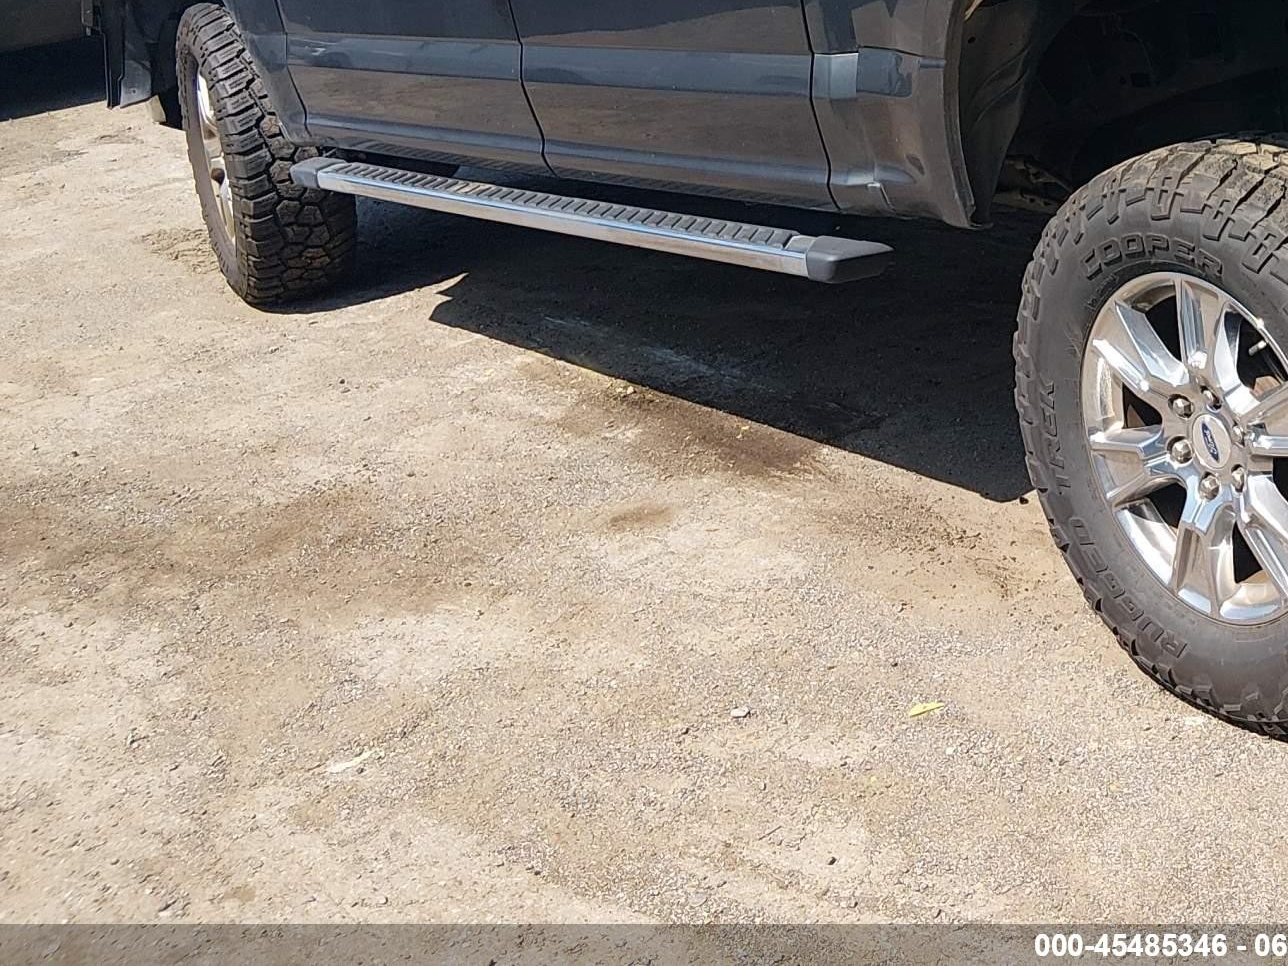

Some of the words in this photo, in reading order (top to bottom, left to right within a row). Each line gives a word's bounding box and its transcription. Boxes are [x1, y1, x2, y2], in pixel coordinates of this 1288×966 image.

[1083, 232, 1224, 280] COOPER
[1040, 381, 1072, 489] TREK
[1069, 517, 1188, 659] RUGGED
